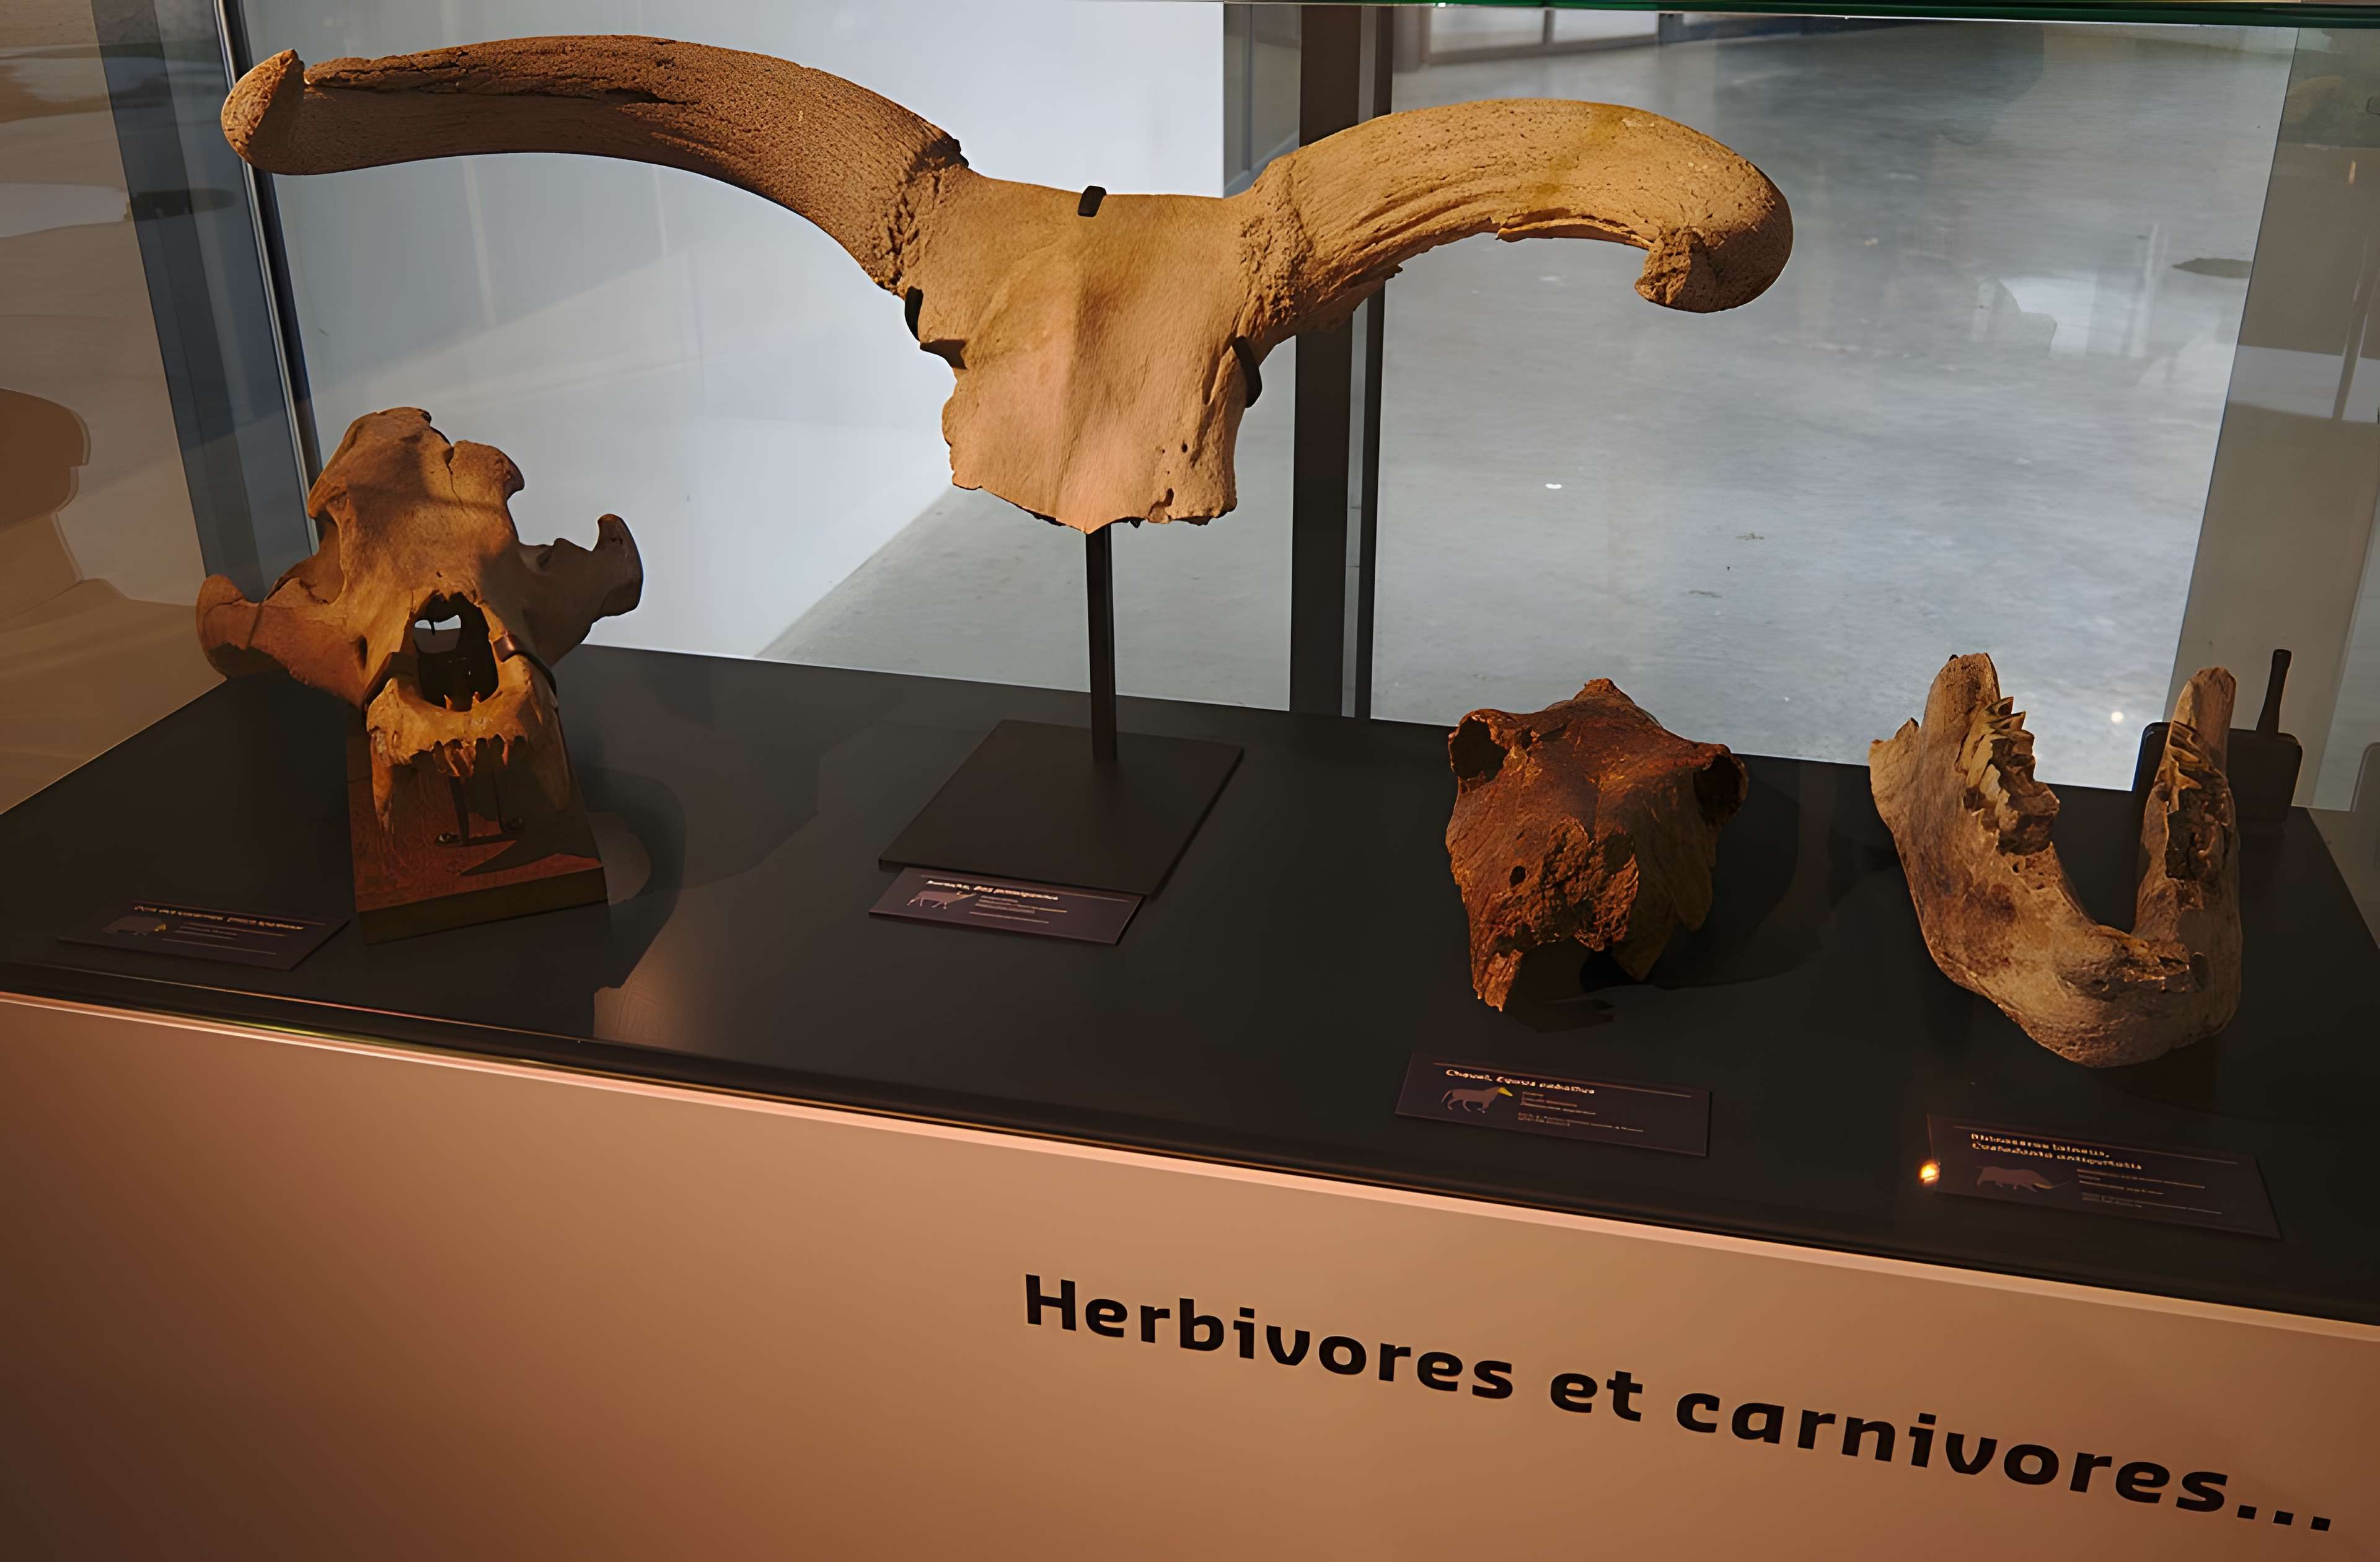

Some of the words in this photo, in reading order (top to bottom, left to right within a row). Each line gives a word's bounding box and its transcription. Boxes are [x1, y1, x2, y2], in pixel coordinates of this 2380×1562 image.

[1025, 1274, 1514, 1400] Herbivores
[1549, 1370, 1644, 1423] et
[1676, 1393, 2332, 1532] carnivores...
